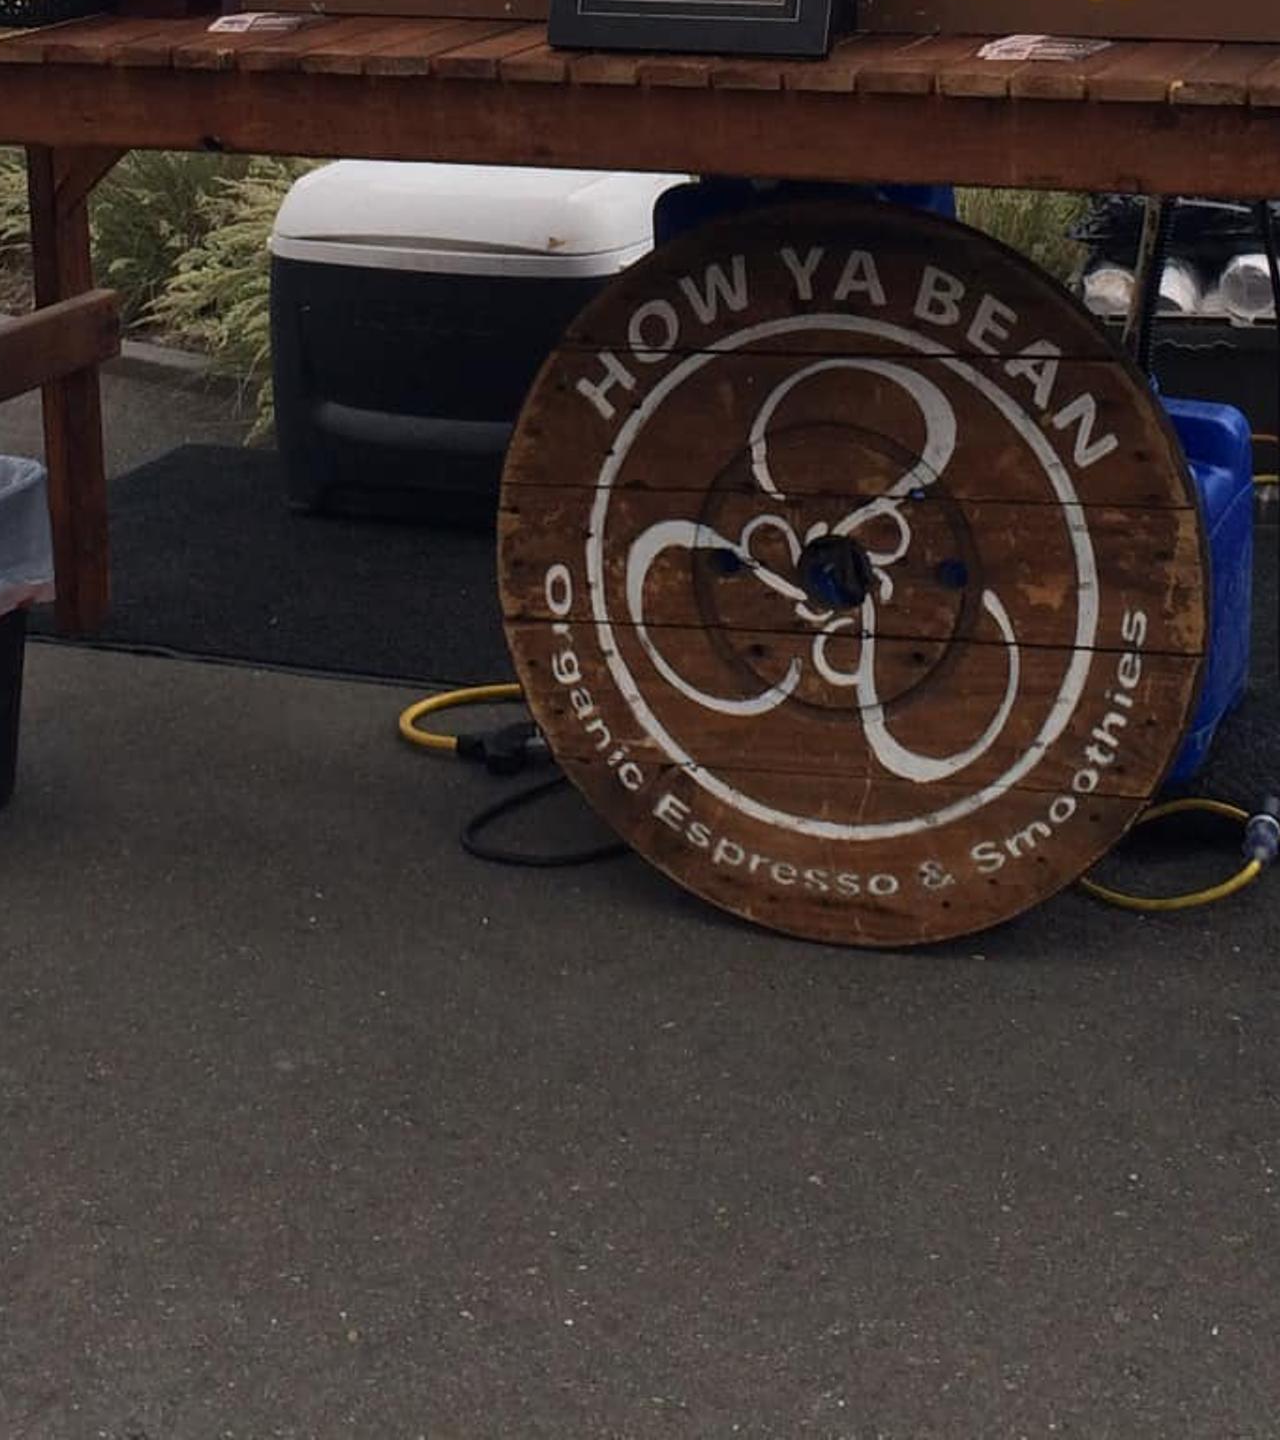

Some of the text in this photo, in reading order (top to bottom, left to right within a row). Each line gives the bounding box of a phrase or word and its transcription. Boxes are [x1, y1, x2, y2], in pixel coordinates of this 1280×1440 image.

[577, 247, 1120, 469] HOW YA BEAN
[544, 563, 1150, 900] Organic Espresso & Smoothies
